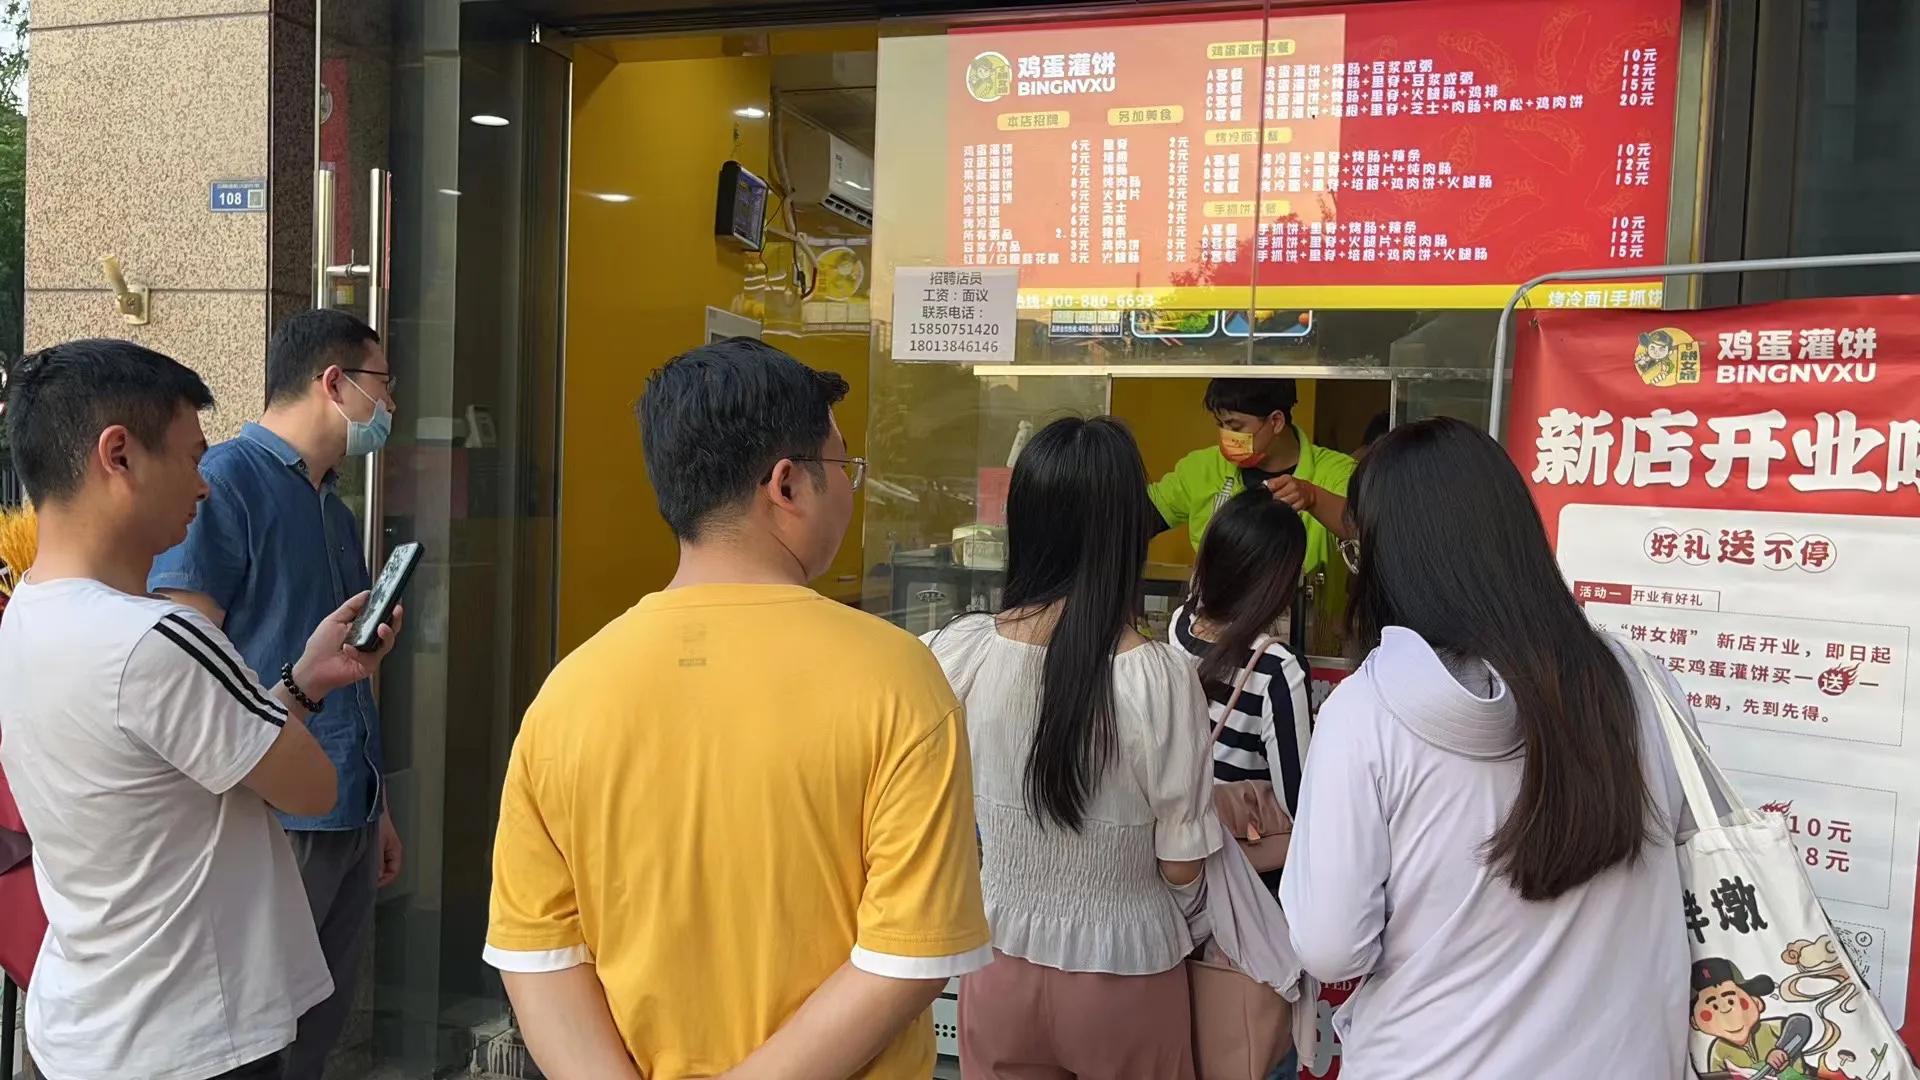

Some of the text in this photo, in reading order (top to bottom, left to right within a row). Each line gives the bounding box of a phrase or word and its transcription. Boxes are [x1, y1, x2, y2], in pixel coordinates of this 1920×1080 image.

[1624, 48, 1658, 62] 10元
[1017, 51, 1116, 79] 鸡蛋灌饼
[1623, 63, 1656, 77] 12元
[1017, 77, 1116, 96] BINGNVXU
[1621, 78, 1655, 92] 15元
[1620, 93, 1655, 107] 20元
[1007, 113, 1059, 128] 本店招牌
[1070, 139, 1090, 151] 6元
[1169, 136, 1190, 149] 2元
[1617, 143, 1651, 157] 10元
[1070, 164, 1090, 177] 7元
[1616, 158, 1650, 171] 12元
[1615, 172, 1649, 186] 15元
[219, 191, 242, 206] 108
[1168, 186, 1189, 200] 2元
[1070, 202, 1090, 214] 6元
[1070, 214, 1090, 227] 6元
[1611, 216, 1645, 230] 10元
[1610, 230, 1645, 244] 12元
[1609, 244, 1644, 258] 15元
[929, 271, 983, 286] 招聘店员
[910, 323, 999, 336] 15850751420
[909, 340, 999, 353] 18013846146
[1717, 327, 1877, 362] 鸡蛋灌饼
[1716, 362, 1877, 384] BINGNVXU
[1649, 528, 1831, 568] 好礼送不停
[1579, 584, 1704, 607] 活动一 开业有好礼
